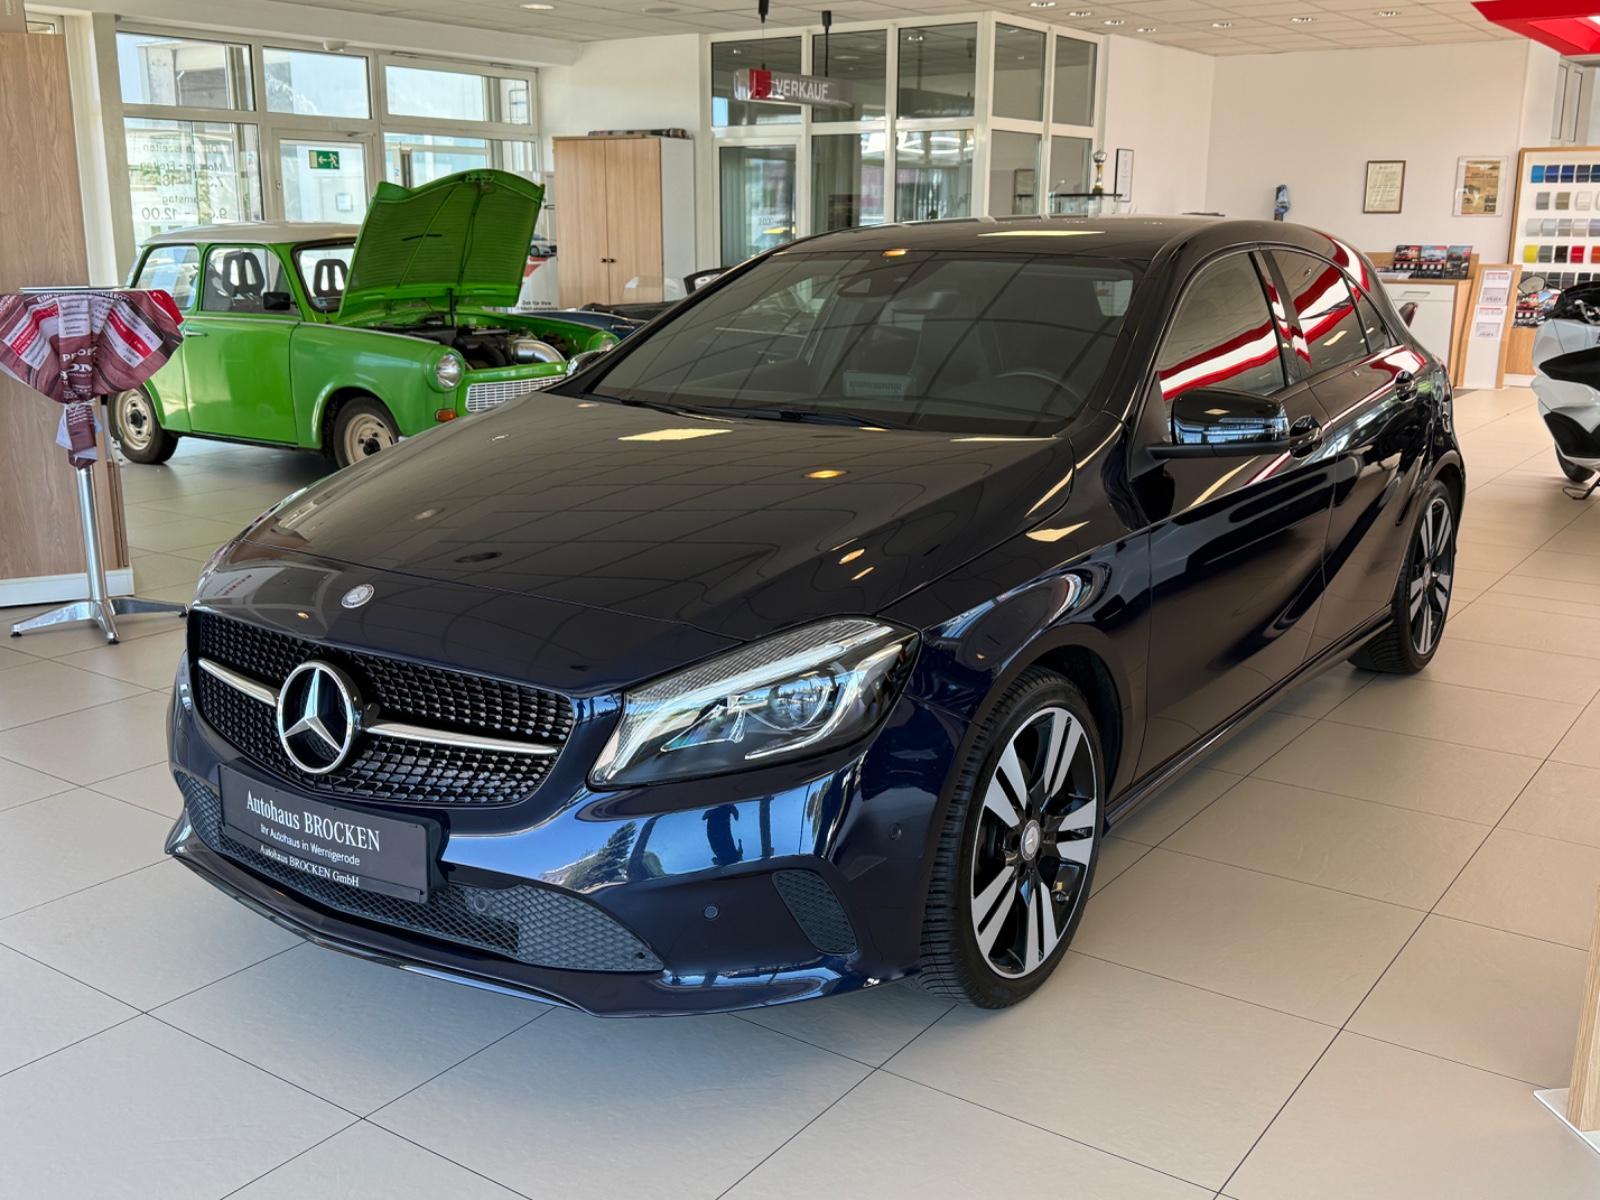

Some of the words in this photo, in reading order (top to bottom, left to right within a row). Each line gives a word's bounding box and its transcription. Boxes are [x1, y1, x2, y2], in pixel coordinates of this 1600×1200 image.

[775, 78, 829, 100] VERKAUF
[246, 790, 300, 830] Autohaus
[303, 811, 381, 852] BROCKEN
[260, 823, 270, 834] Ihr
[269, 828, 301, 849] Autohaus
[301, 838, 309, 851] in
[310, 843, 361, 867] Wernigerode
[260, 845, 288, 865] Autohaus
[289, 857, 330, 879] BROCKEN
[332, 870, 360, 887] GmbH
